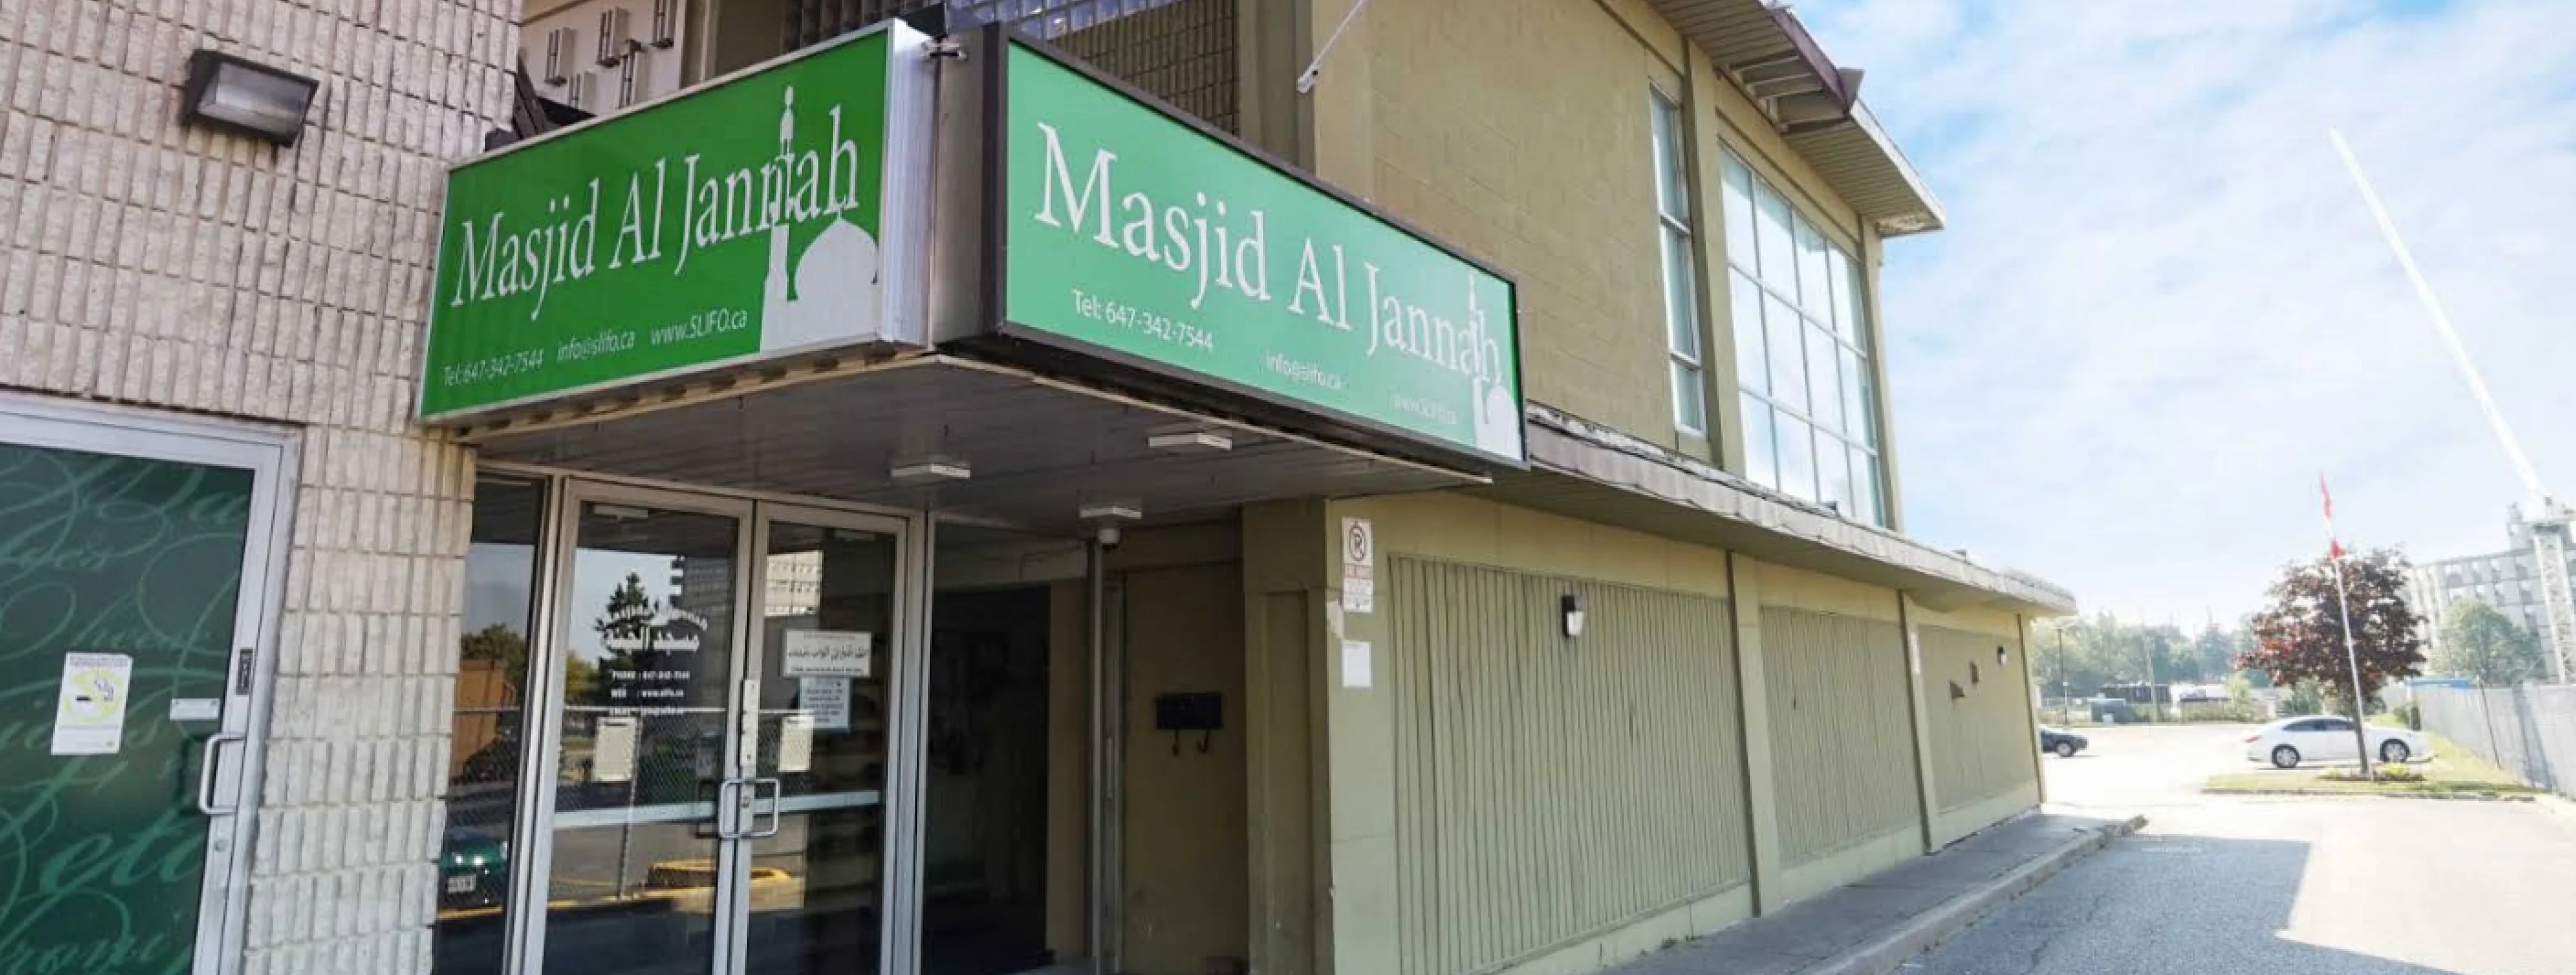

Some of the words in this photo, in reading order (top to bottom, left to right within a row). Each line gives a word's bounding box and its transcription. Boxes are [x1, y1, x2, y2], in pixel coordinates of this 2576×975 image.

[451, 176, 600, 320] Masjid
[608, 156, 666, 270] Al
[674, 103, 860, 275] Jannah
[1034, 122, 1271, 309] Masjid
[1288, 237, 1353, 330] Al
[1363, 262, 1503, 385] Jannah
[650, 308, 747, 346] www.SLIFO.ca
